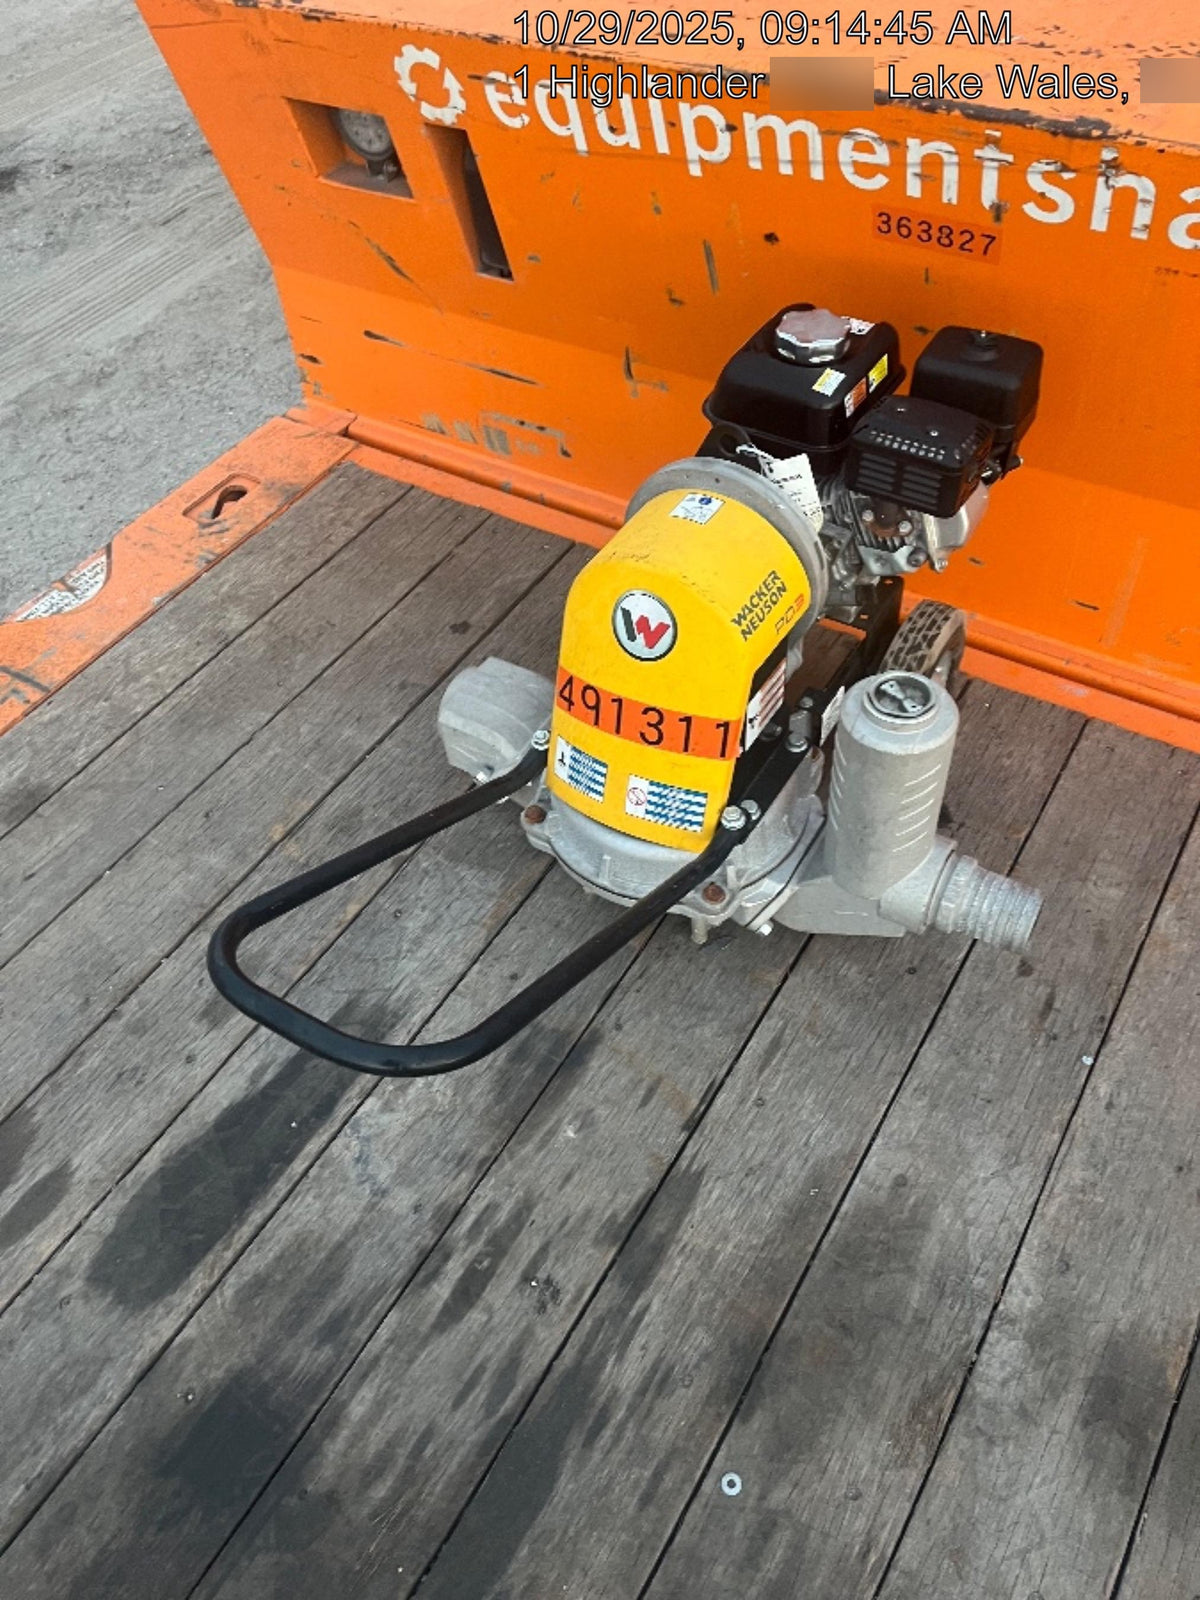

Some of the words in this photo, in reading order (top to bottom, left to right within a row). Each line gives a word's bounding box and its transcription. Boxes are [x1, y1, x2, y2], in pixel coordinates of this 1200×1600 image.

[876, 211, 997, 256] 363827
[730, 570, 782, 627] WACKER
[741, 581, 787, 642] NEUSON
[558, 674, 731, 758] 491311
